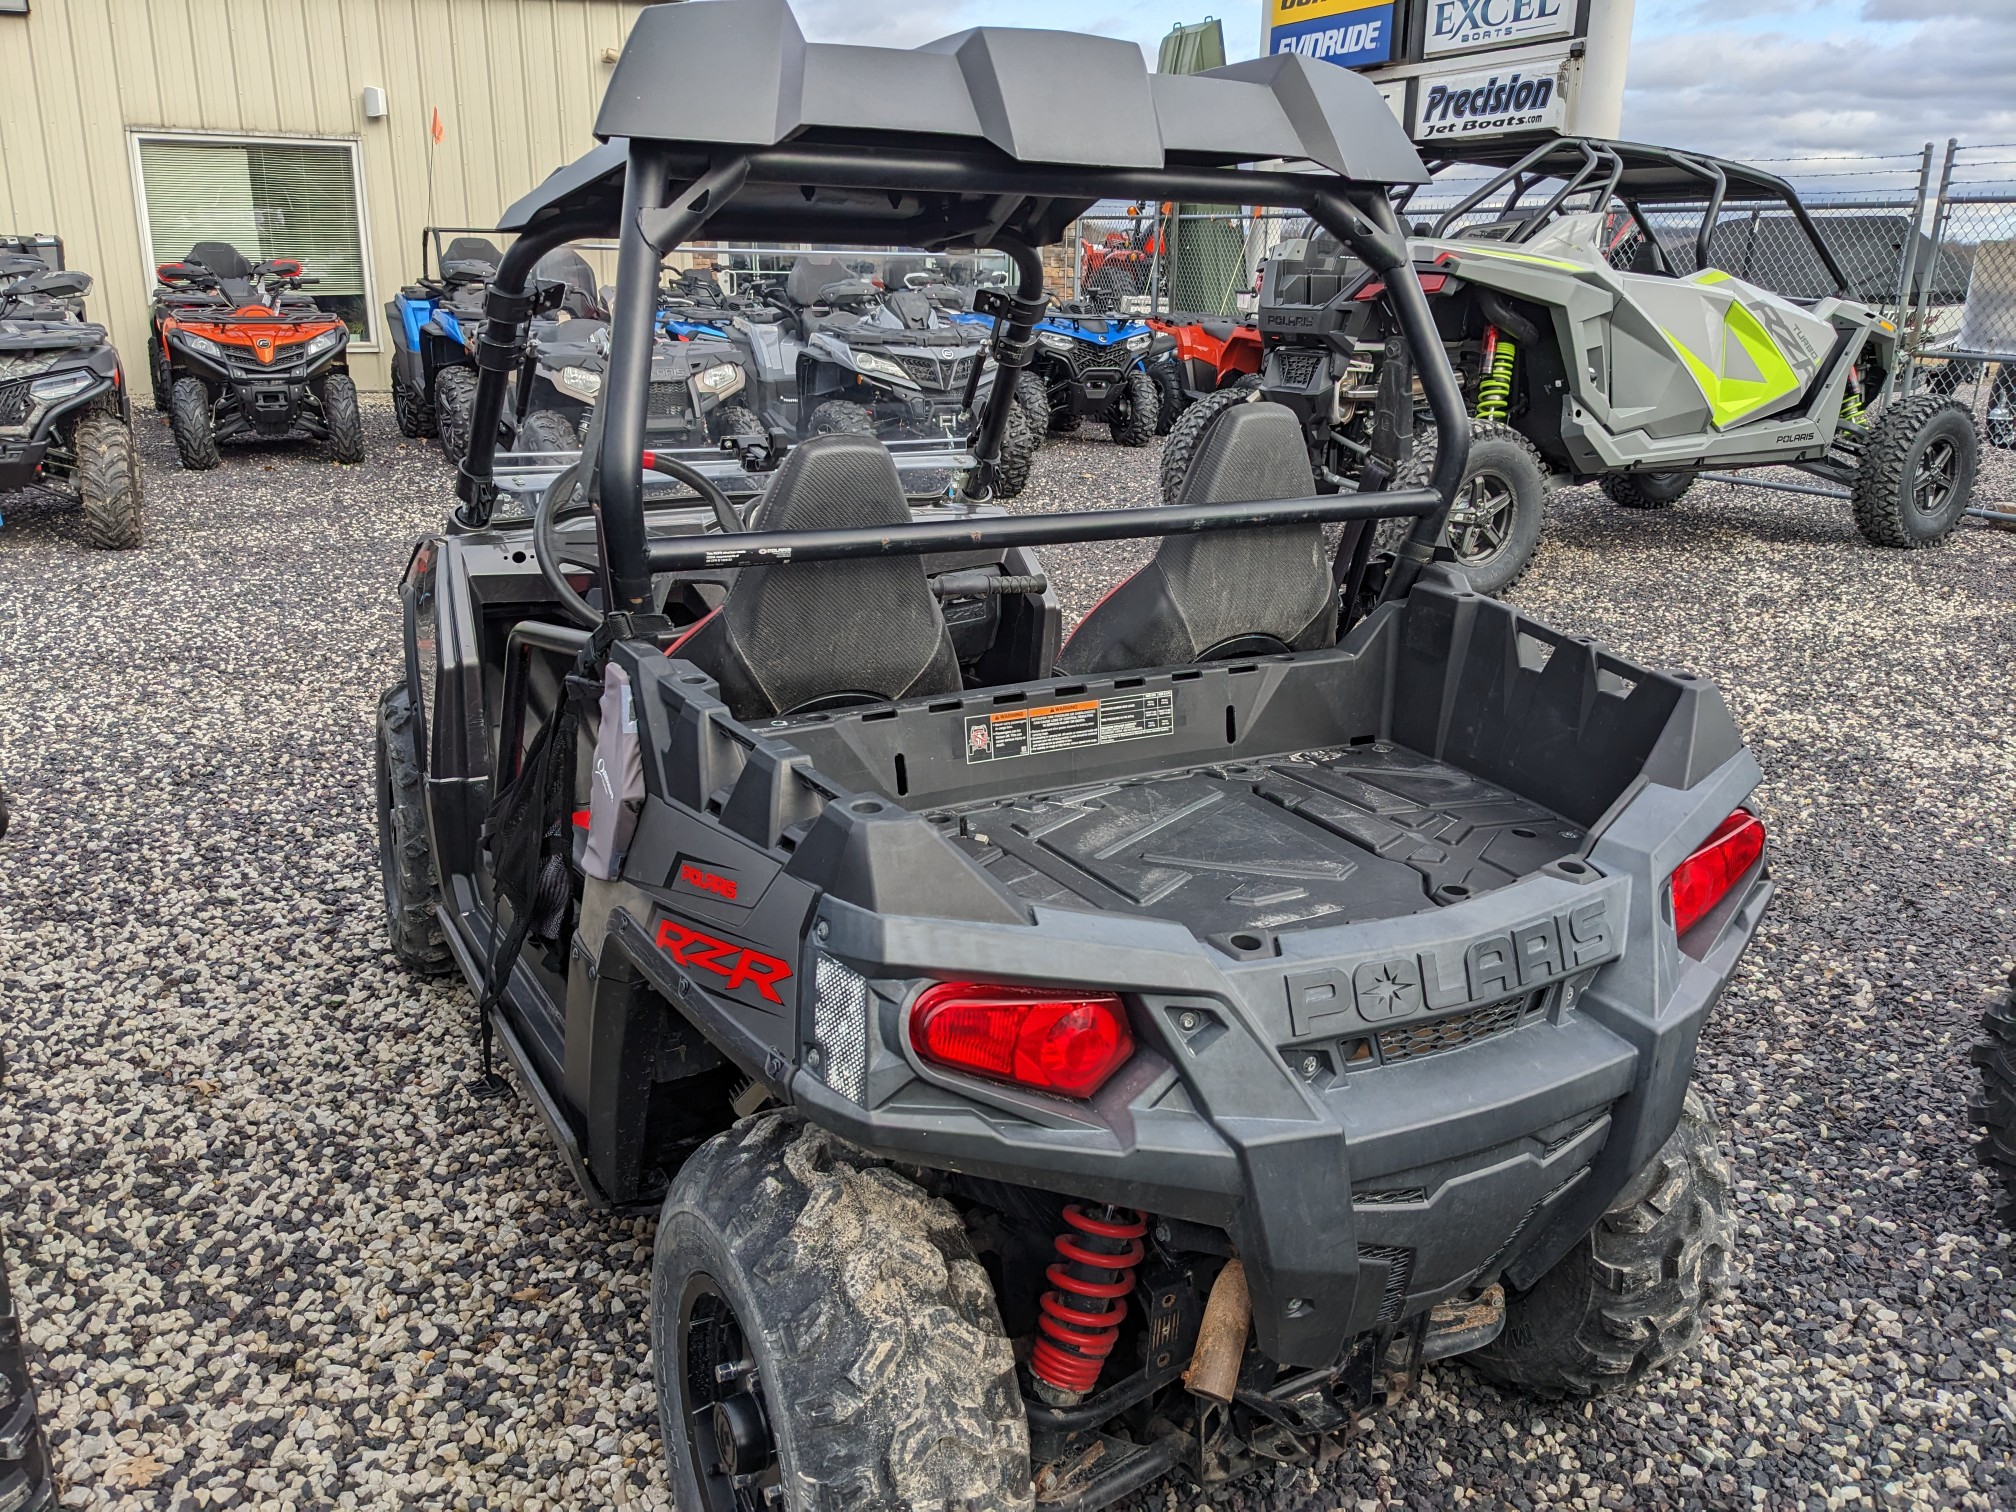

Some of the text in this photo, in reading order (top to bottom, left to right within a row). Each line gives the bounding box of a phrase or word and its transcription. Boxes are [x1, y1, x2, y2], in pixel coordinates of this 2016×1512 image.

[1432, 0, 1561, 40] EXCEL
[1461, 27, 1513, 42] BOATS
[1278, 21, 1382, 58] EVINRUDE
[1423, 74, 1553, 123] Precision
[1424, 115, 1542, 137] Jet Boats.com
[1268, 315, 1314, 327] POLARIS
[1793, 323, 1819, 360] TURBO
[1776, 432, 1815, 444] POLARIS
[1000, 711, 1024, 720] WARNING
[1055, 704, 1078, 713] WARNING
[681, 863, 739, 901] POLARIS
[655, 917, 794, 1006] RZR
[1283, 900, 1613, 1038] POLARIS
